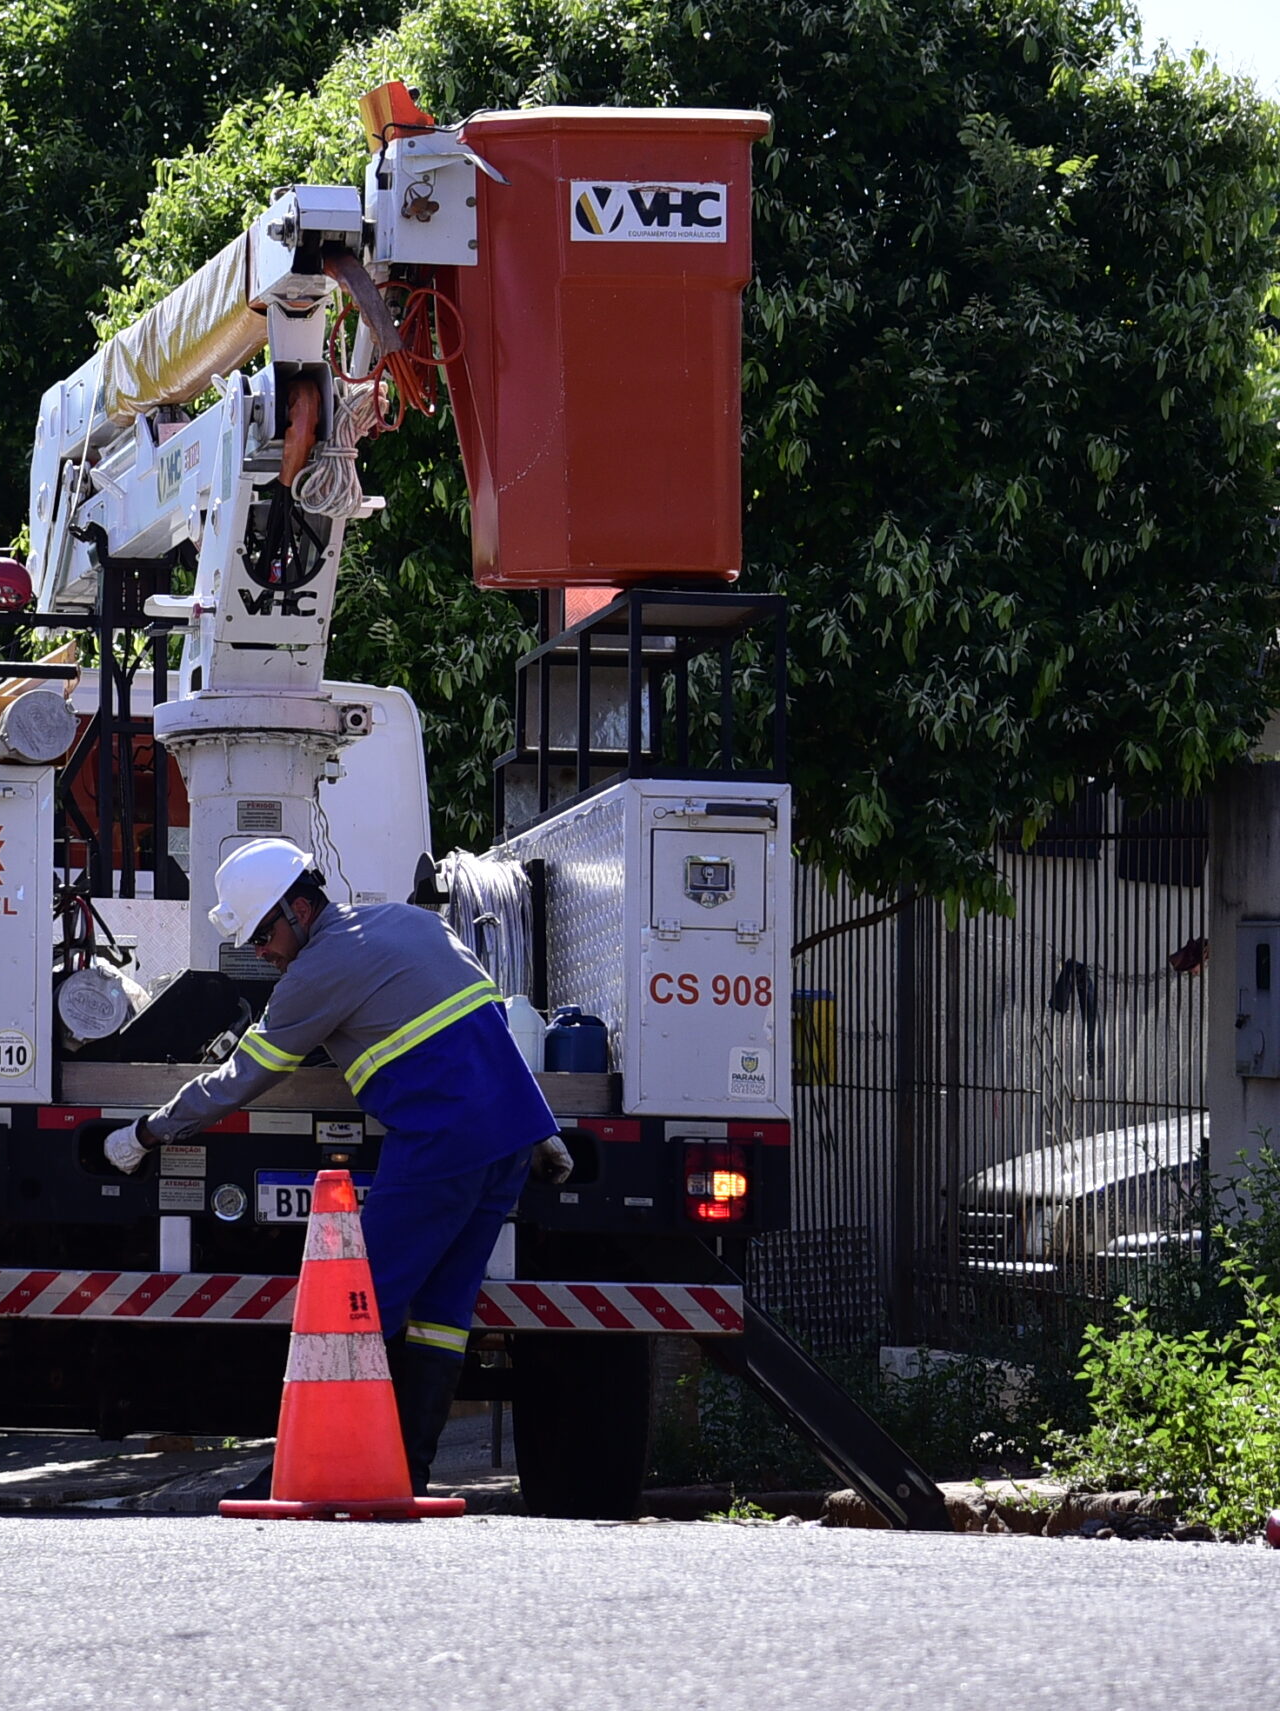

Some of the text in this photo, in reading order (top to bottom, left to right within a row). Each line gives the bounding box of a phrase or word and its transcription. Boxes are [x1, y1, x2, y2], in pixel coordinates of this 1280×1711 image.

[627, 190, 722, 227] VHC
[628, 230, 721, 238] EQUIPAMENTOS HIDRÁULICOS
[238, 589, 317, 617] VHC
[649, 972, 772, 1007] CS 908
[731, 1073, 766, 1081] PARANÁ
